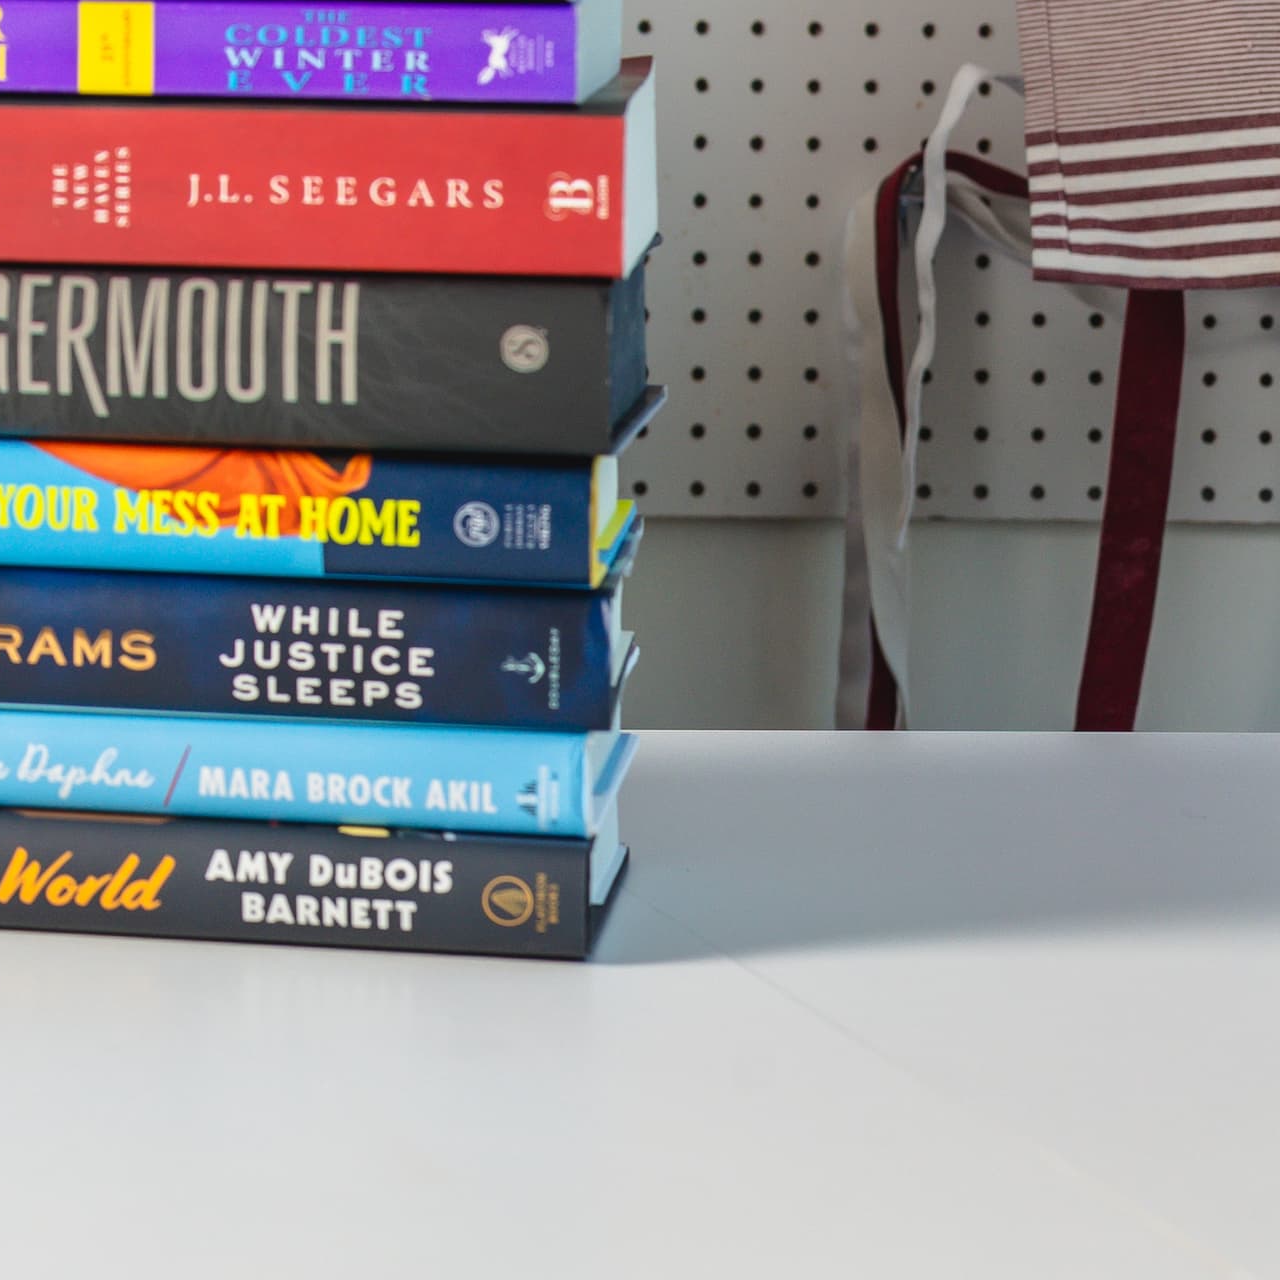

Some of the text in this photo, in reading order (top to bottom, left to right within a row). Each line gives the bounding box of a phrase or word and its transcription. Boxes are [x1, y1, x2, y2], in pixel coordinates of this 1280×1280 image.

[225, 24, 432, 49] COLDEST
[224, 48, 430, 72] WINTER
[227, 71, 427, 95] EVER
[52, 164, 67, 207] THE
[74, 164, 88, 209] NEW
[94, 150, 109, 223] HAVEN
[115, 146, 130, 227] SERIES
[188, 175, 504, 208] J.L. SEEGARS
[114, 489, 220, 538] MESS
[236, 494, 286, 538] AT
[300, 495, 421, 547] HOME
[250, 604, 404, 639] WHILE
[219, 639, 434, 676] JUSTICE
[232, 675, 423, 710] SLEEPS
[16, 743, 154, 799] Daphne
[198, 766, 293, 801] MARA
[307, 772, 411, 808] BROCK
[426, 779, 497, 814] AKIL
[205, 849, 453, 893] AMY DuBOIS
[242, 892, 417, 932] BARNETT
